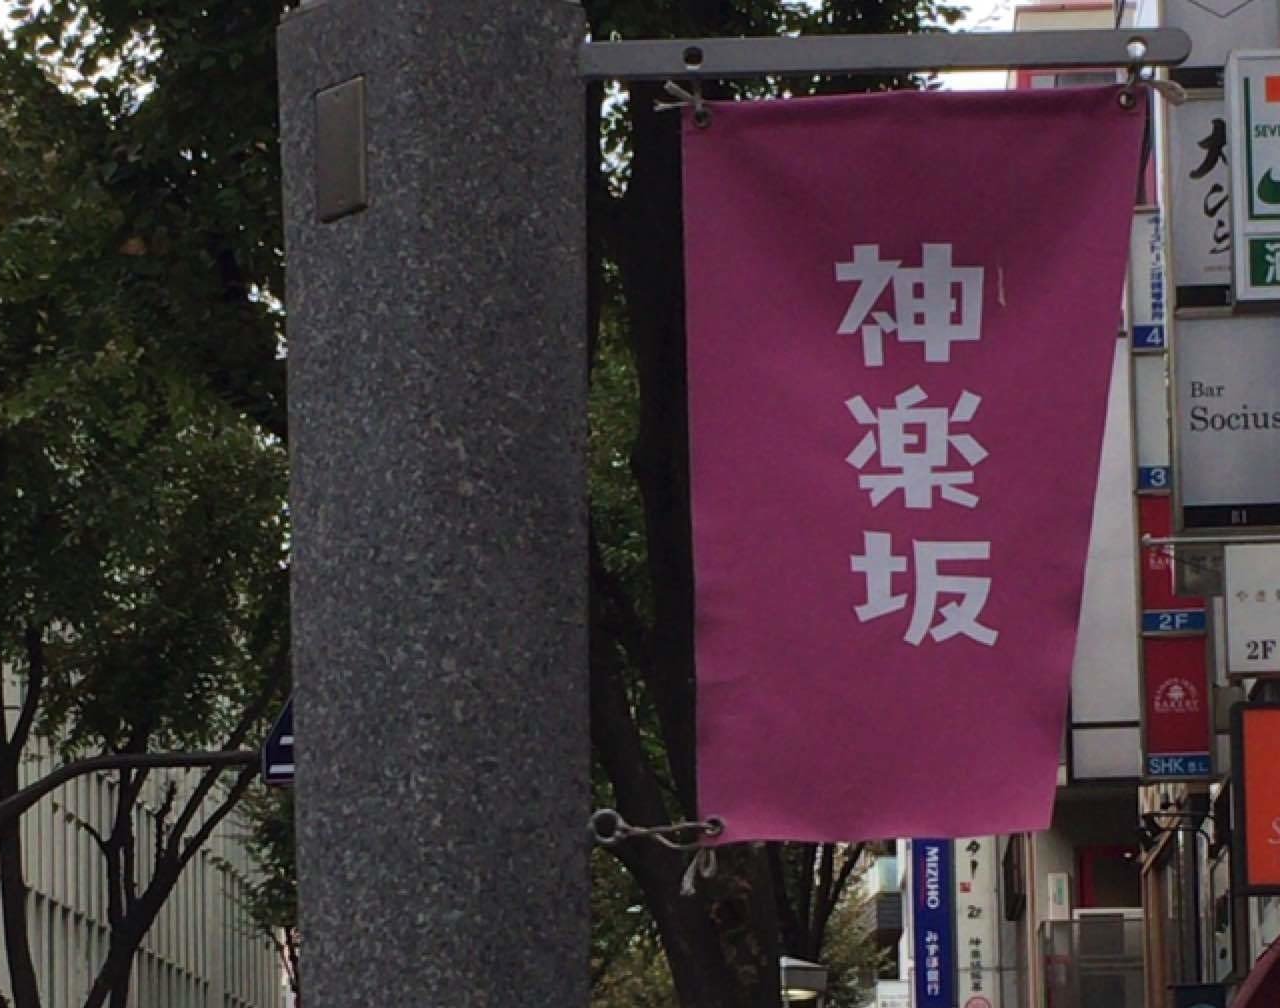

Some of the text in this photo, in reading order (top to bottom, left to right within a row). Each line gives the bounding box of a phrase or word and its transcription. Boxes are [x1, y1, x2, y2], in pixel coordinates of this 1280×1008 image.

[1147, 327, 1162, 345] 4
[1190, 382, 1224, 398] Bar
[833, 242, 1000, 647] 神楽坂
[1150, 469, 1166, 488] 3
[1159, 615, 1190, 631] 2F
[1246, 640, 1277, 660] 2F
[1149, 758, 1185, 774] SHK
[925, 846, 940, 910] MIZUHO
[925, 930, 940, 997] みずほ銀行
